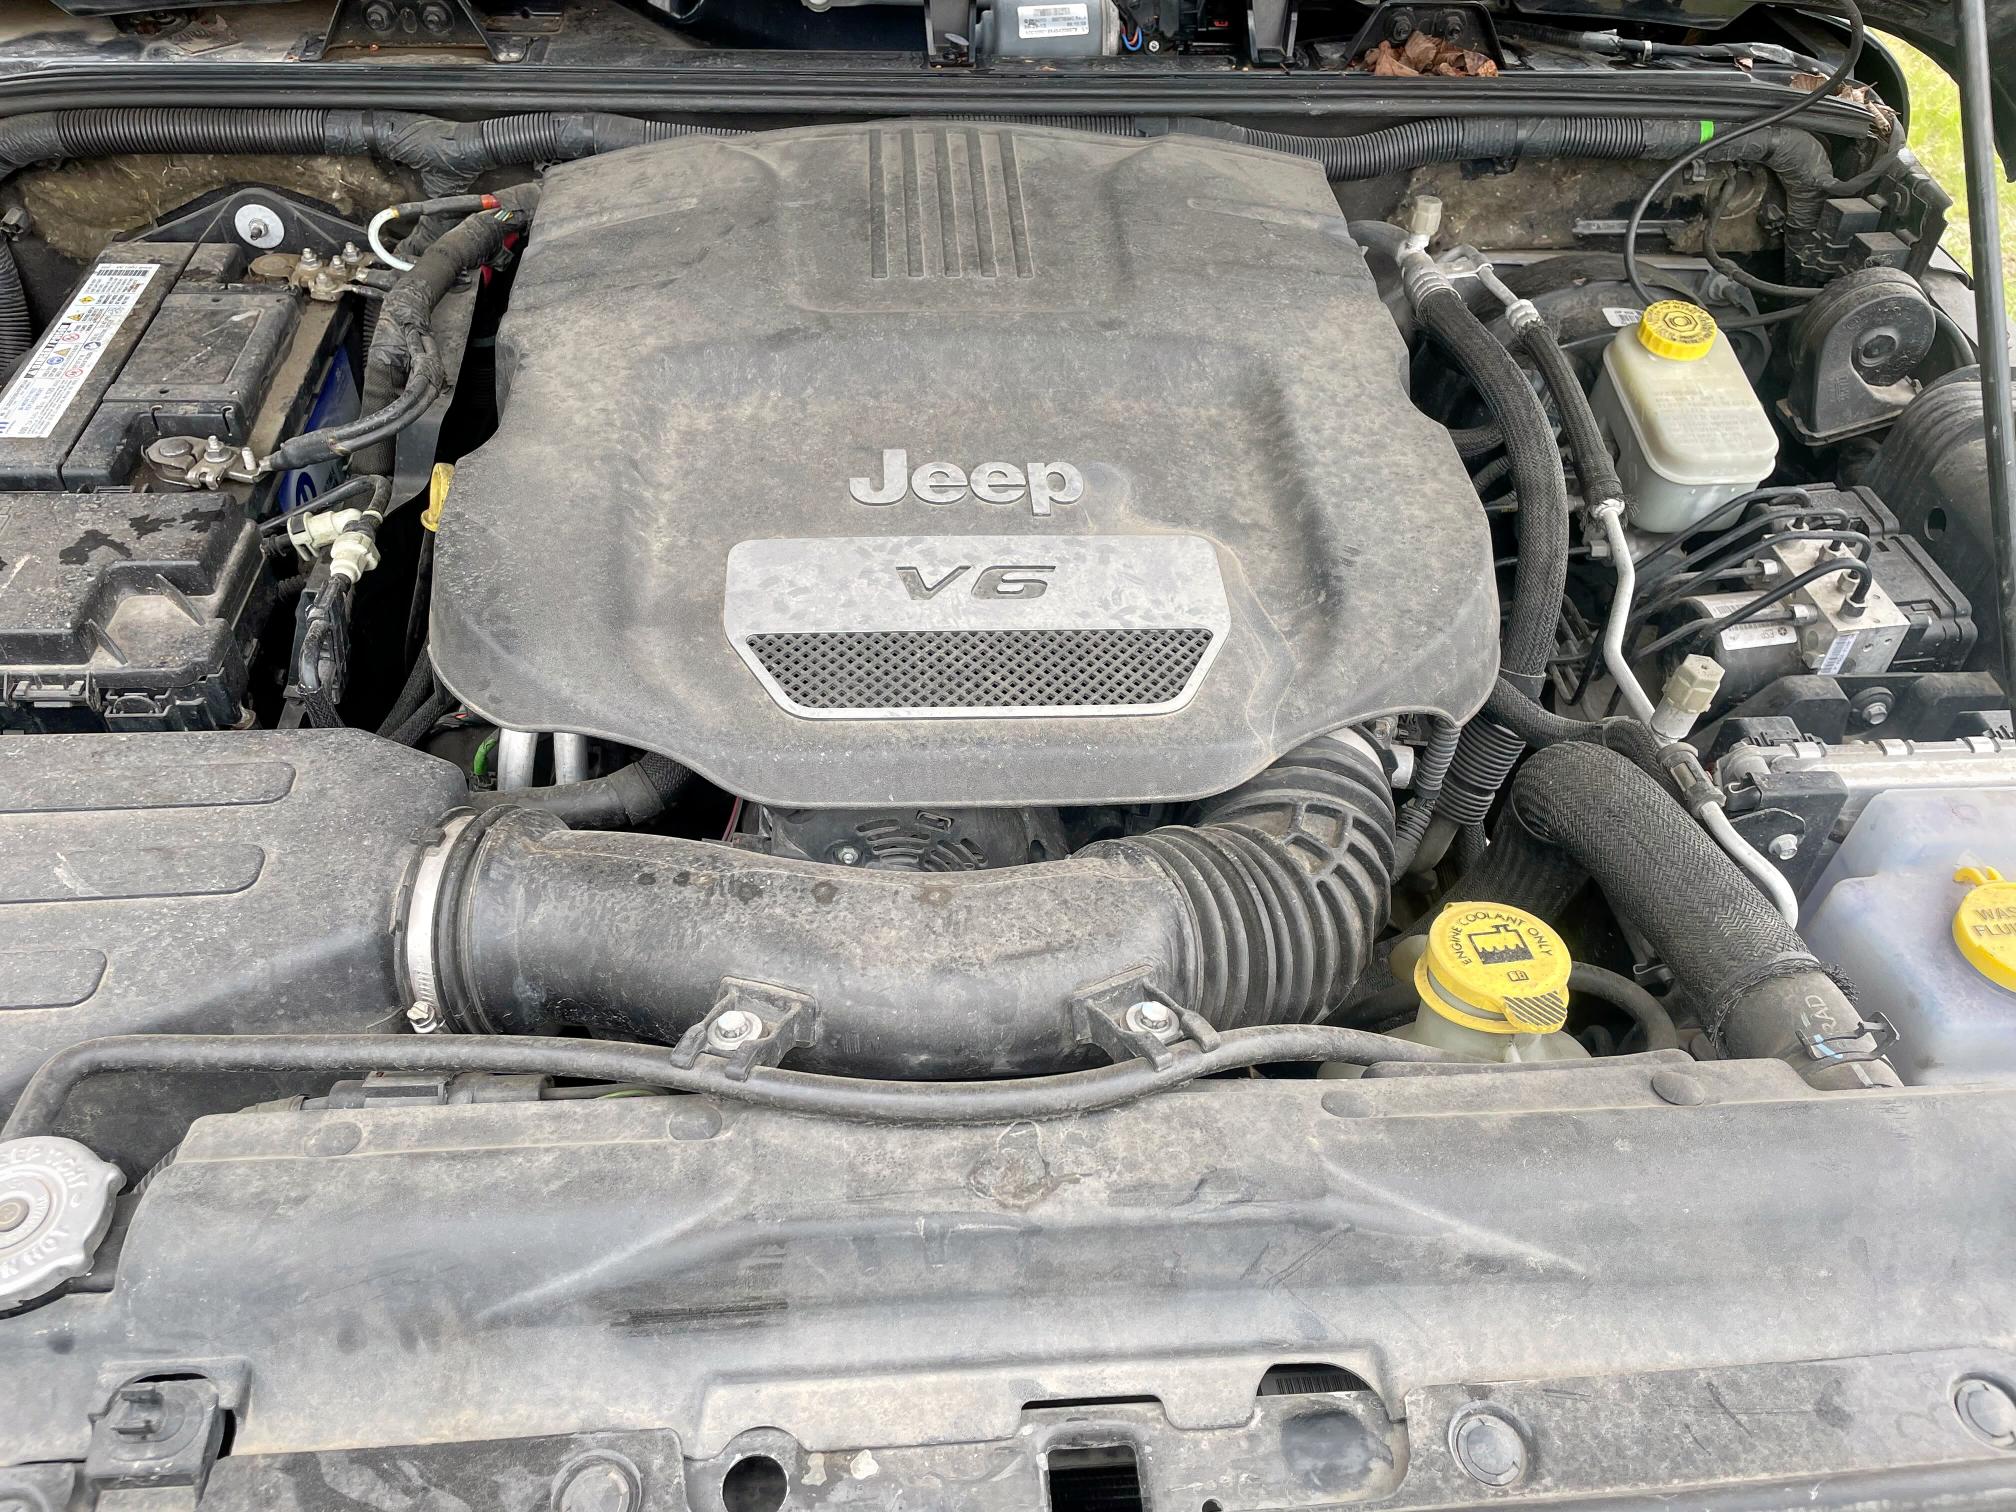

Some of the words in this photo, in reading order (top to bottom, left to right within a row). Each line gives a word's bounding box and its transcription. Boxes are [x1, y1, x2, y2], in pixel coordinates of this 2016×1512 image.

[849, 449, 1084, 516] Jeep
[896, 565, 1056, 600] V6
[1460, 911, 1527, 927] COOLANT
[1450, 926, 1472, 966] ENGINE
[1528, 927, 1553, 956] ONLY
